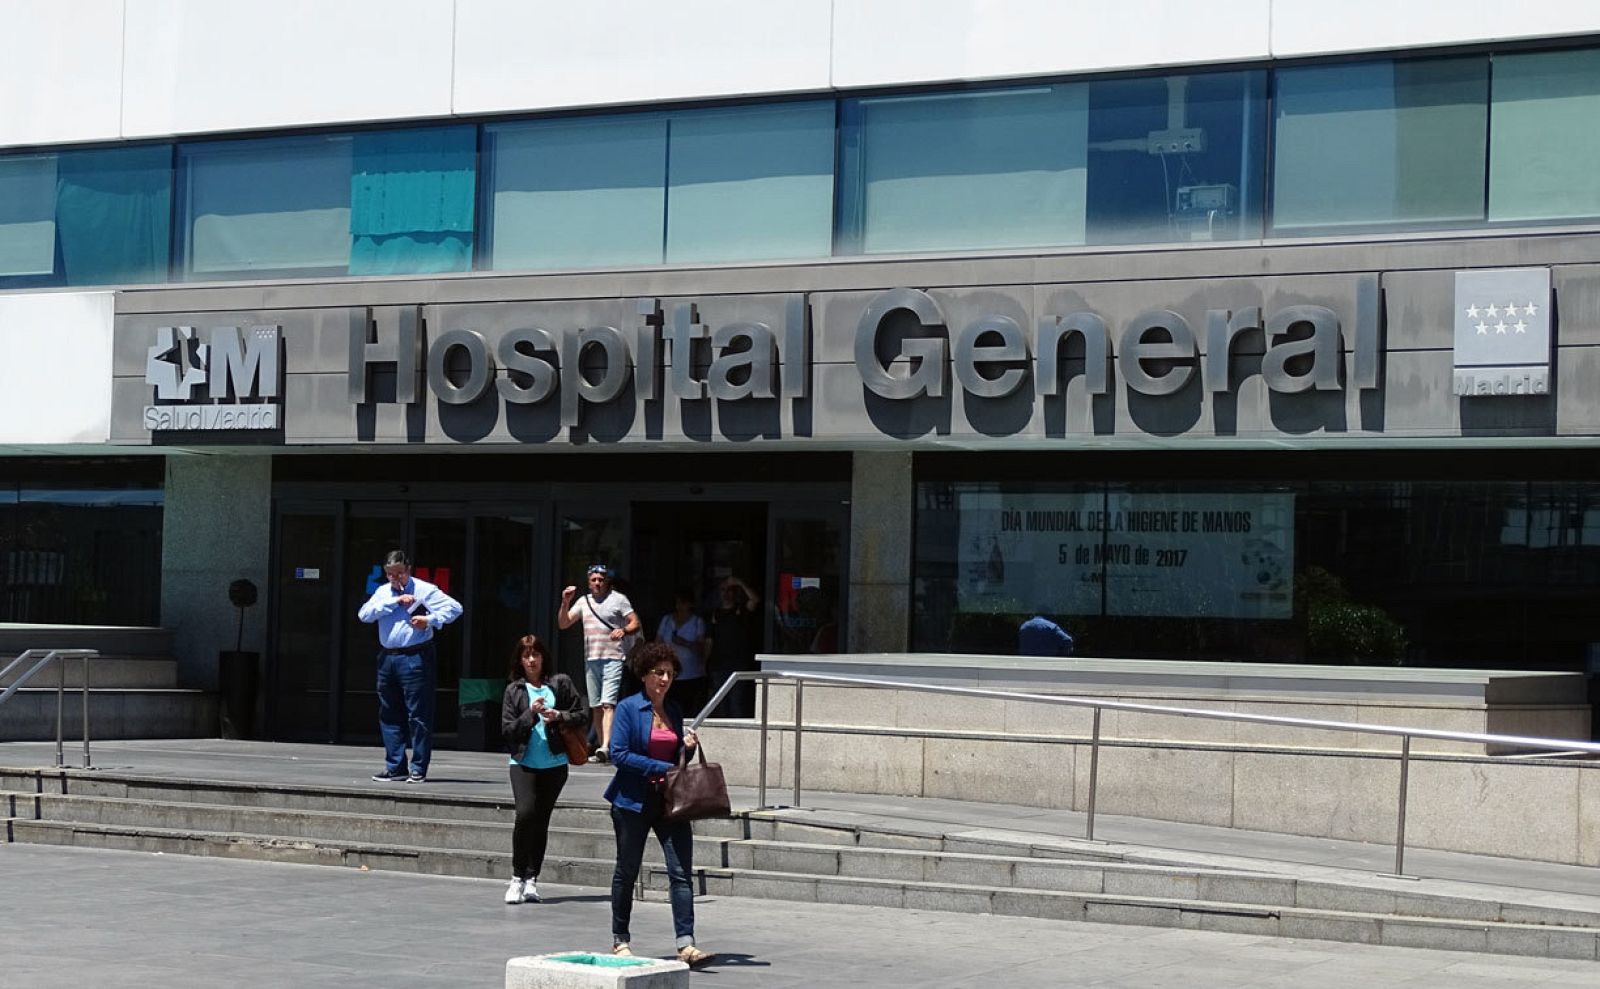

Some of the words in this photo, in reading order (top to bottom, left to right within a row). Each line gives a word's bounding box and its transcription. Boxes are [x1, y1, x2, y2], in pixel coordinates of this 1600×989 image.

[209, 325, 281, 397] M
[348, 293, 809, 427] Hospital
[854, 278, 1381, 399] General
[1455, 374, 1548, 395] Madrid
[1002, 507, 1022, 532] DÍA
[1027, 511, 1084, 532] MUNDIAL
[1089, 511, 1104, 532] DE
[1108, 511, 1123, 532] LA
[1129, 511, 1178, 532] HIGIENE
[1183, 511, 1198, 532] DE
[1203, 511, 1252, 532] MANOS
[1059, 544, 1067, 565] 5
[1076, 545, 1090, 565] de
[1095, 544, 1130, 565] MAYO
[1136, 545, 1150, 566] de
[1157, 549, 1189, 567] 2017
